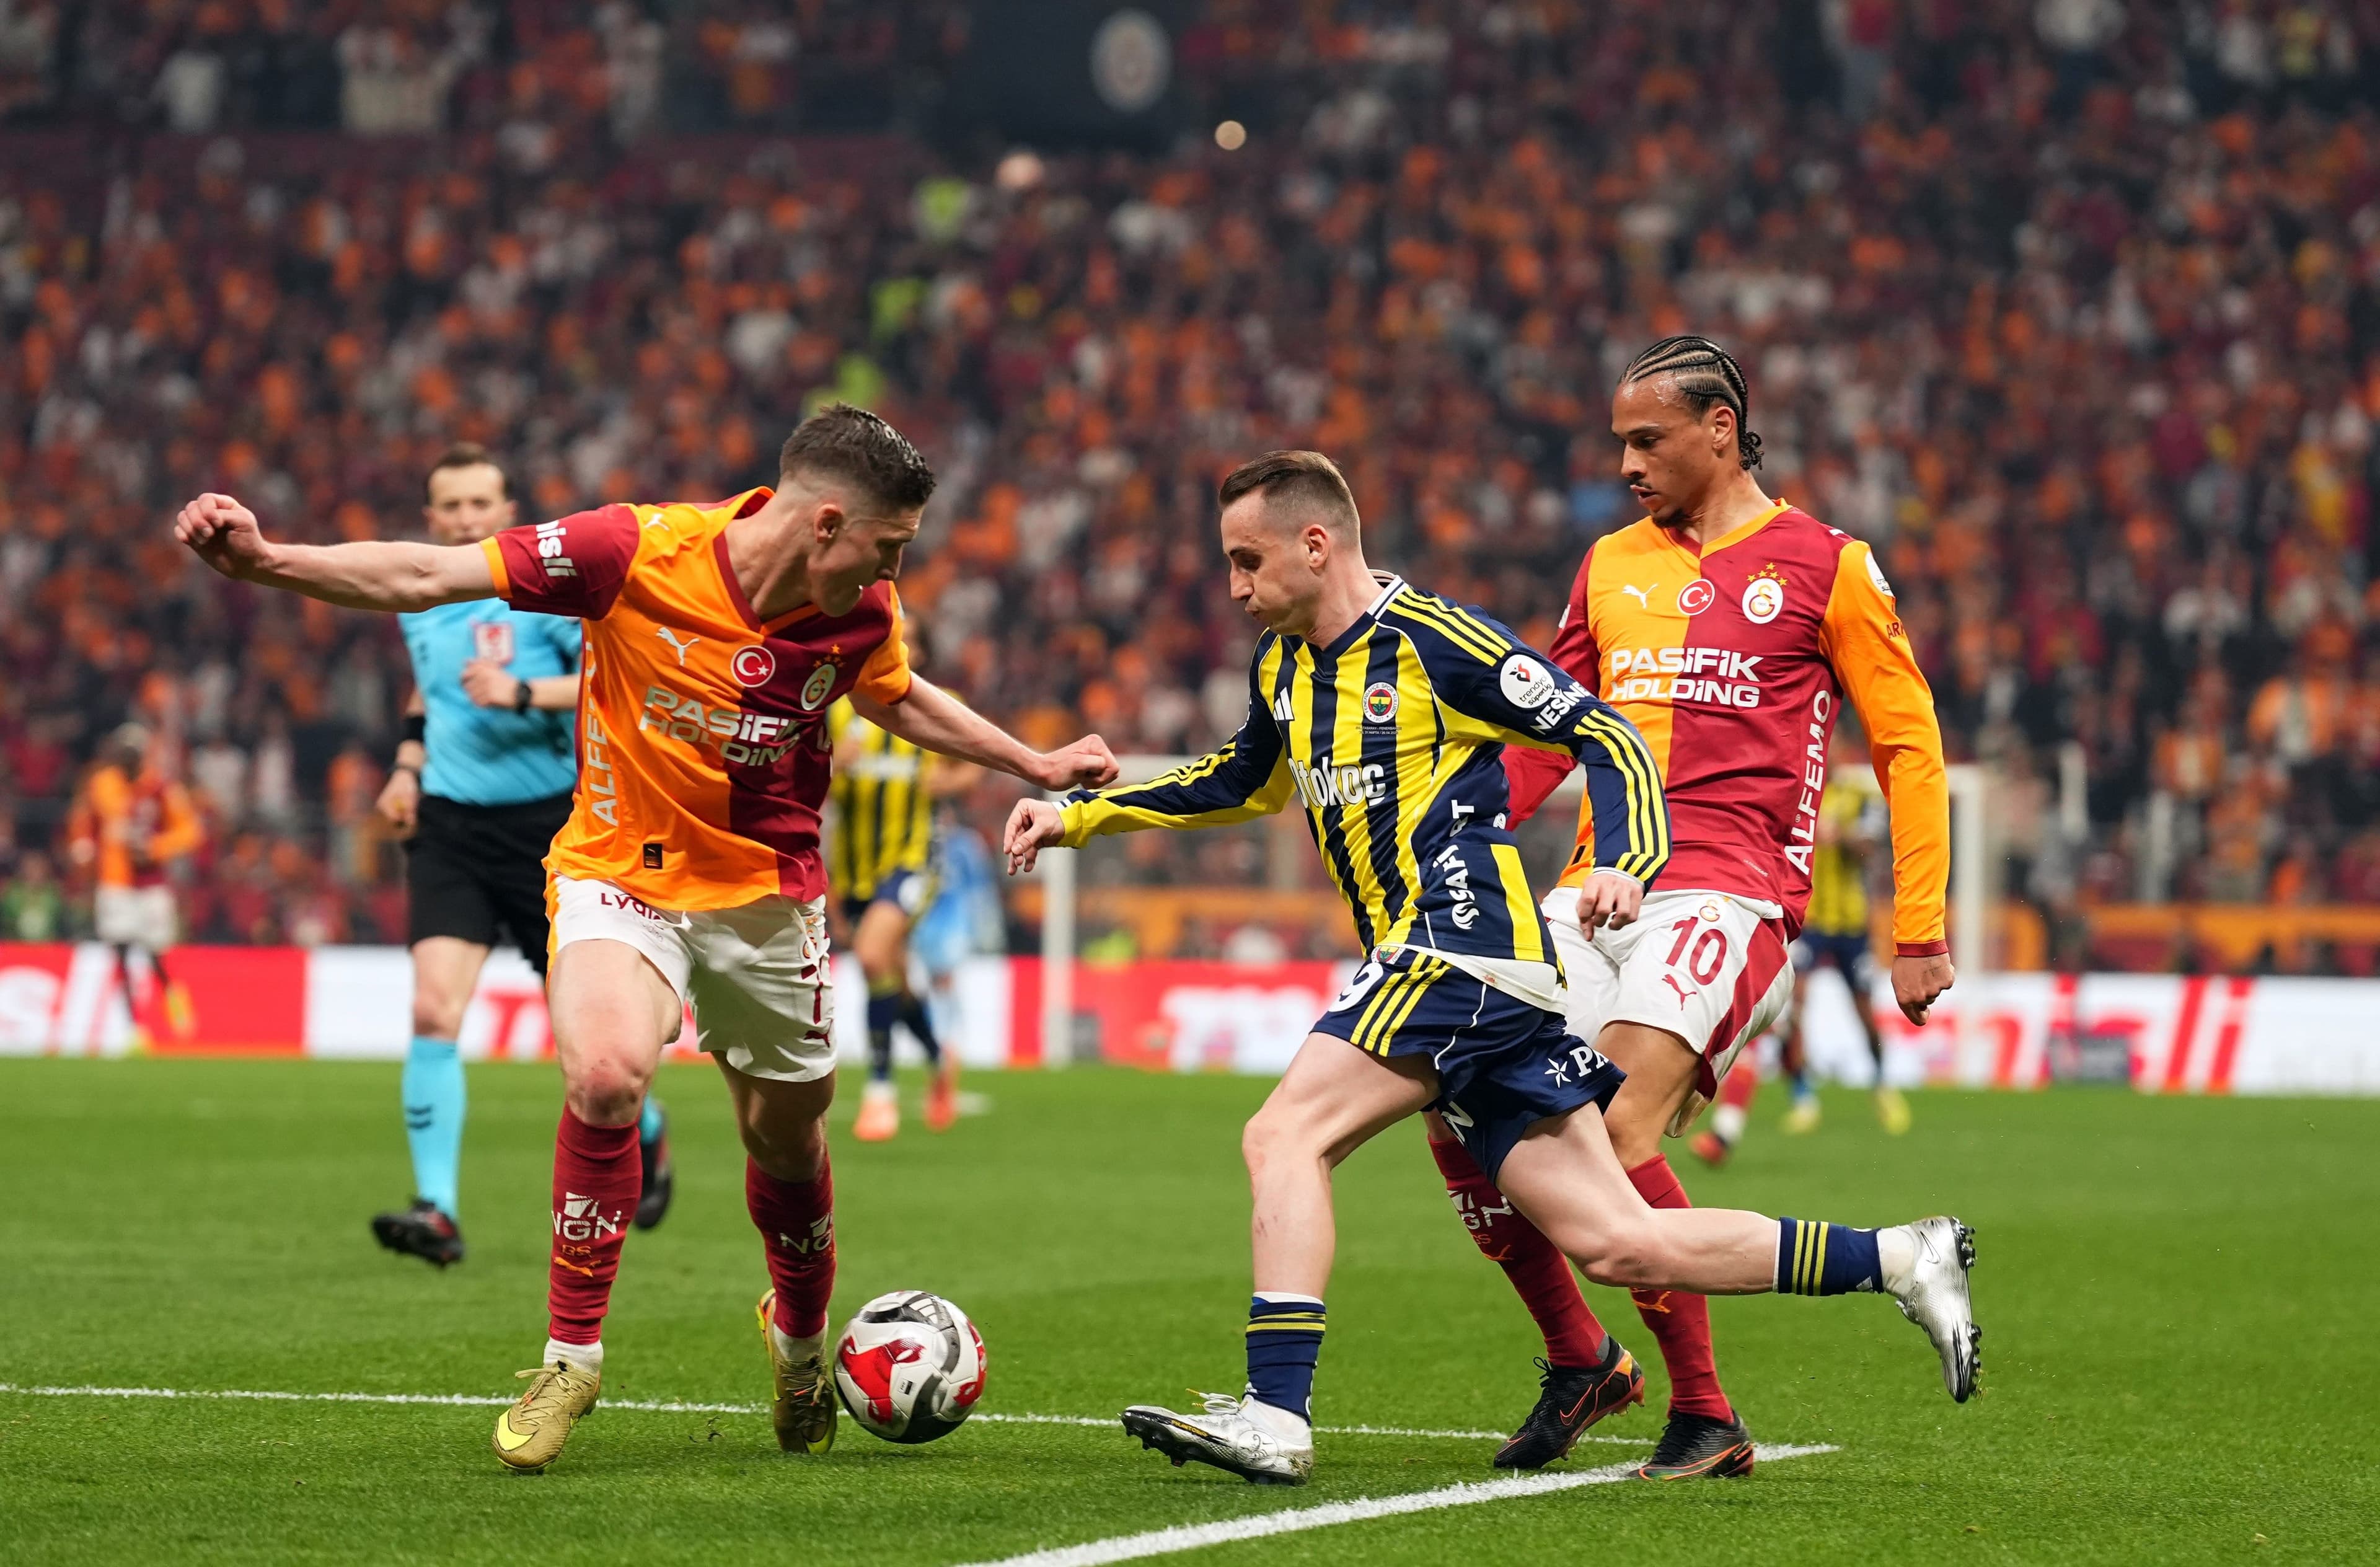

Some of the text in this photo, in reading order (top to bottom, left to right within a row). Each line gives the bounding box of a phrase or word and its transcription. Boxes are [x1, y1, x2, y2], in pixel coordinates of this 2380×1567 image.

[1784, 690, 1831, 876] ALFEMO
[1665, 916, 1727, 986] 10
[1328, 962, 1384, 1012] 9
